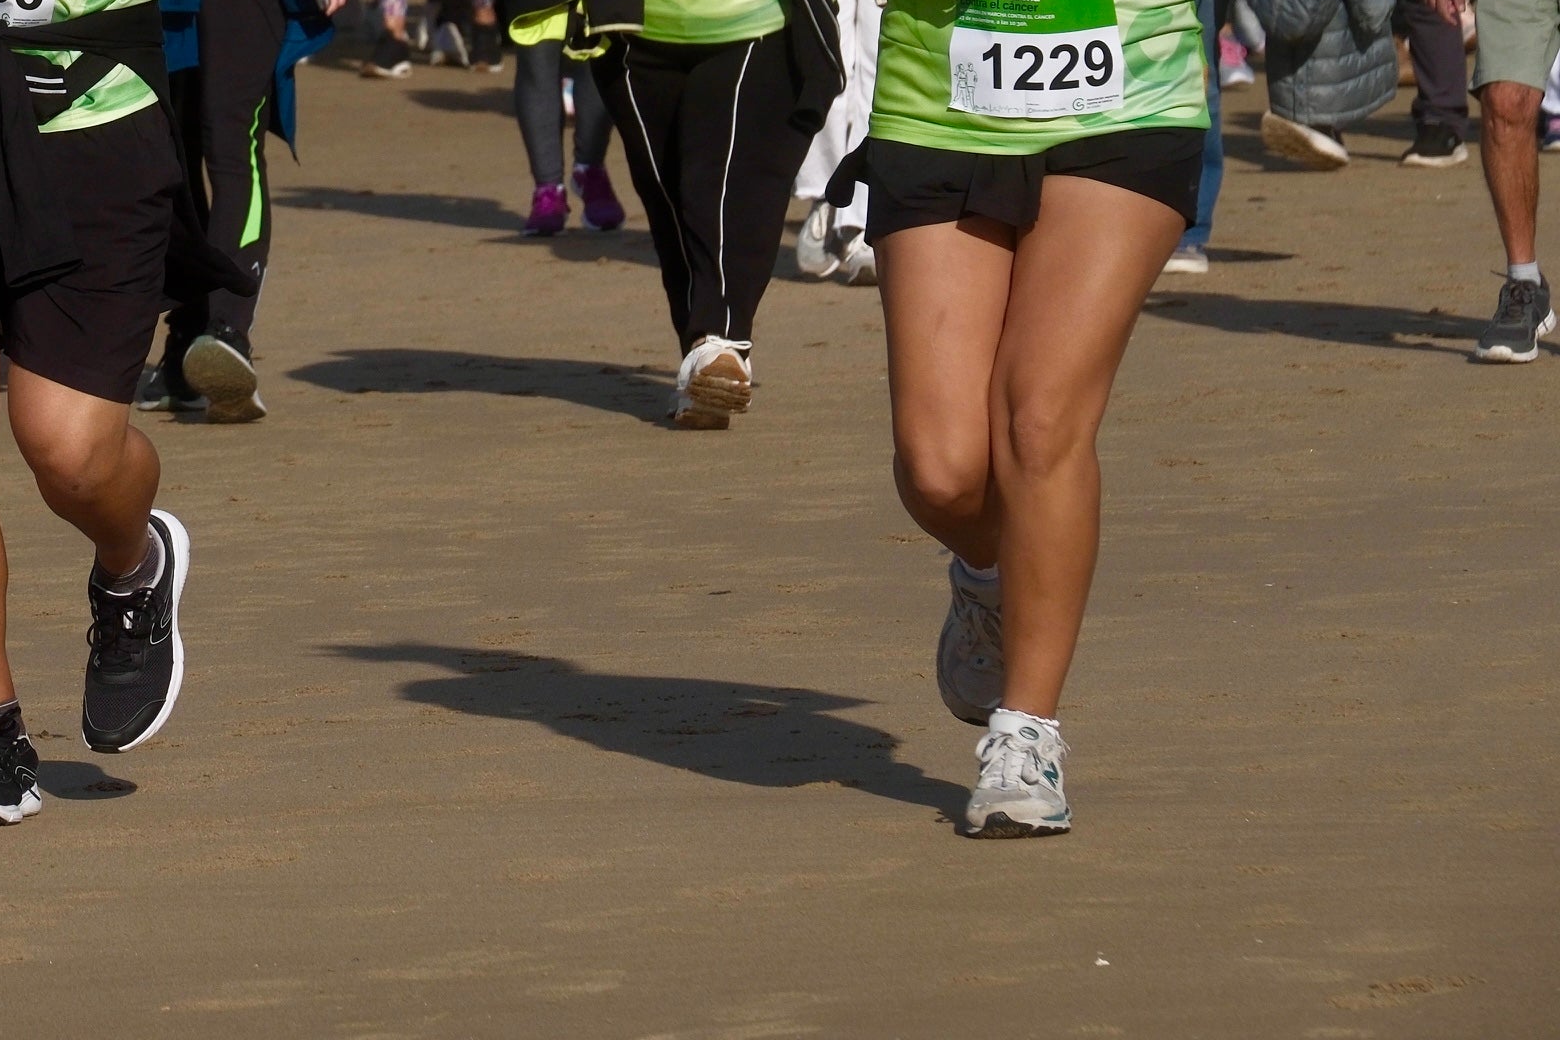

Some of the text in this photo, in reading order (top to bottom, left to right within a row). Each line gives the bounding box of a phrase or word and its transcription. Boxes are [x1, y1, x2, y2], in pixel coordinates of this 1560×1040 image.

[989, 0, 1000, 10] el
[1002, 1, 1039, 12] cáncer
[982, 40, 1114, 91] 1229
